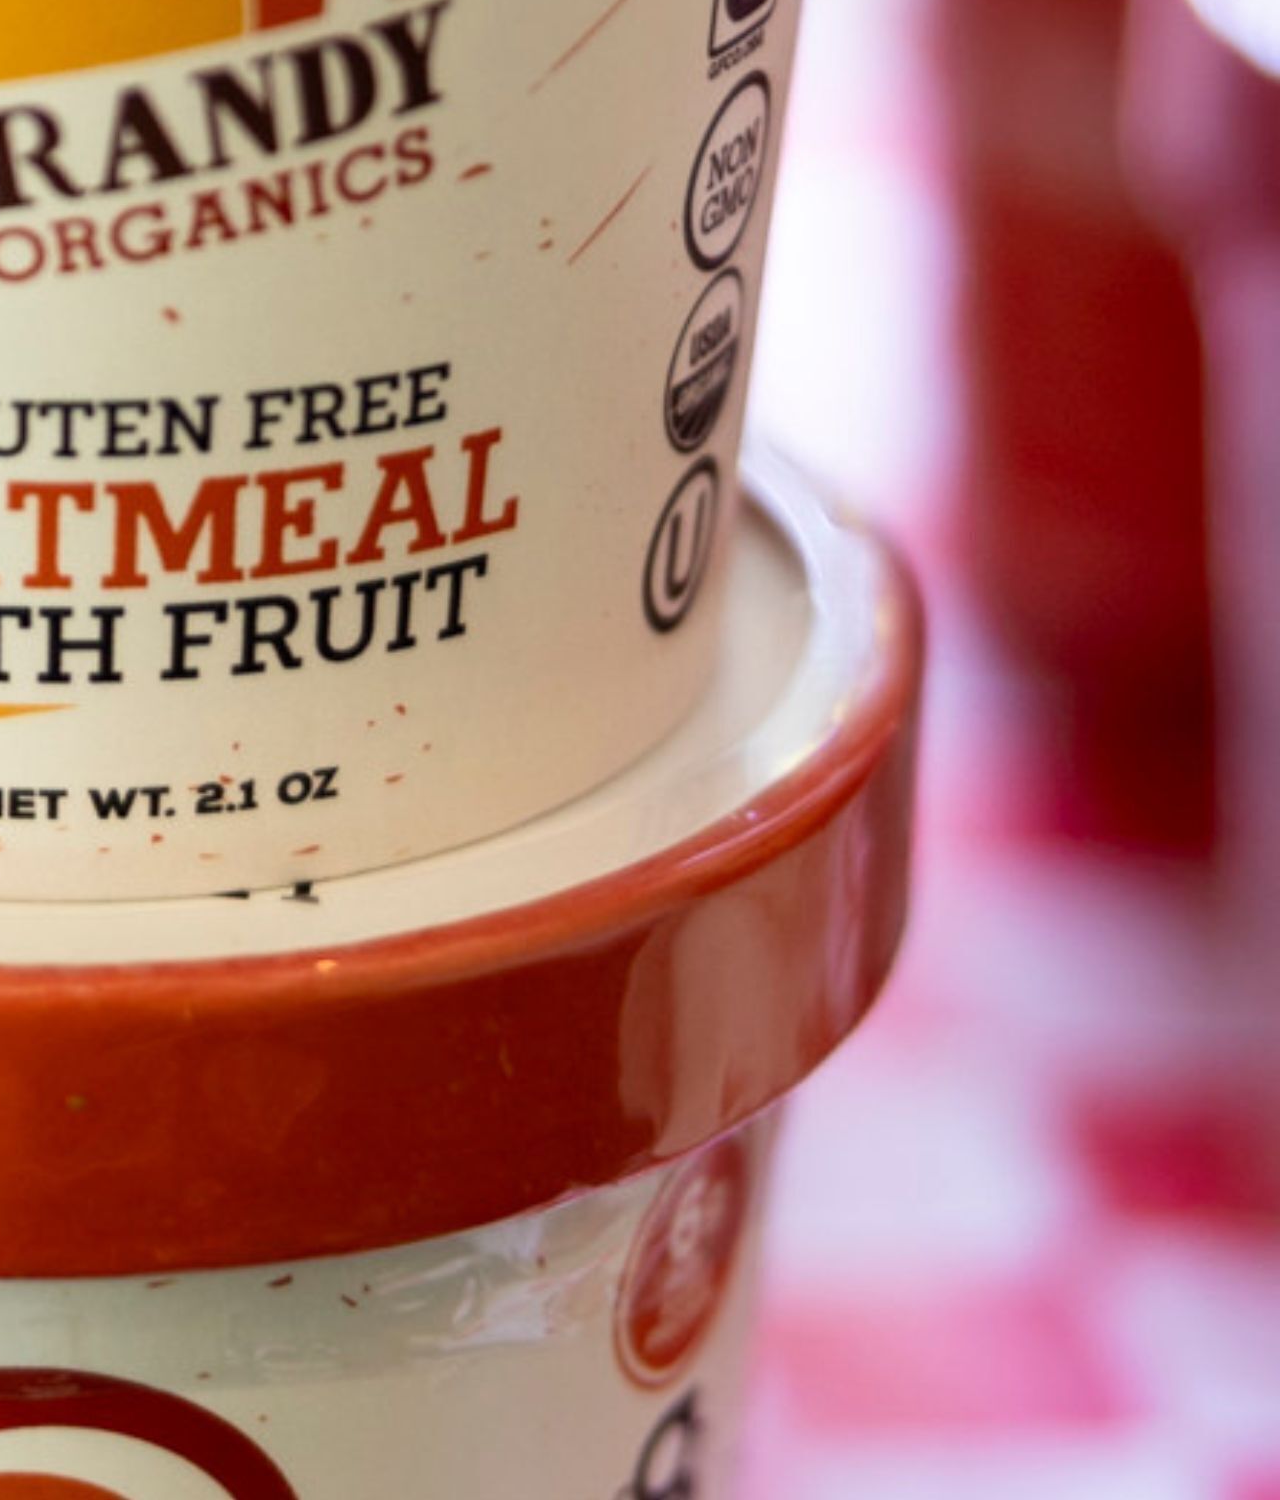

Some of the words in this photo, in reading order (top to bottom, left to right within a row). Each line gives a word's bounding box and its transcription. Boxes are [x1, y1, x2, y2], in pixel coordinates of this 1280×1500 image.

[706, 116, 761, 192] NON
[700, 165, 755, 236] GMO
[242, 361, 452, 451] FREE
[159, 553, 490, 682] FRUIT
[87, 786, 177, 821] WT.
[194, 778, 259, 815] 2.1
[276, 765, 340, 806] OZ
